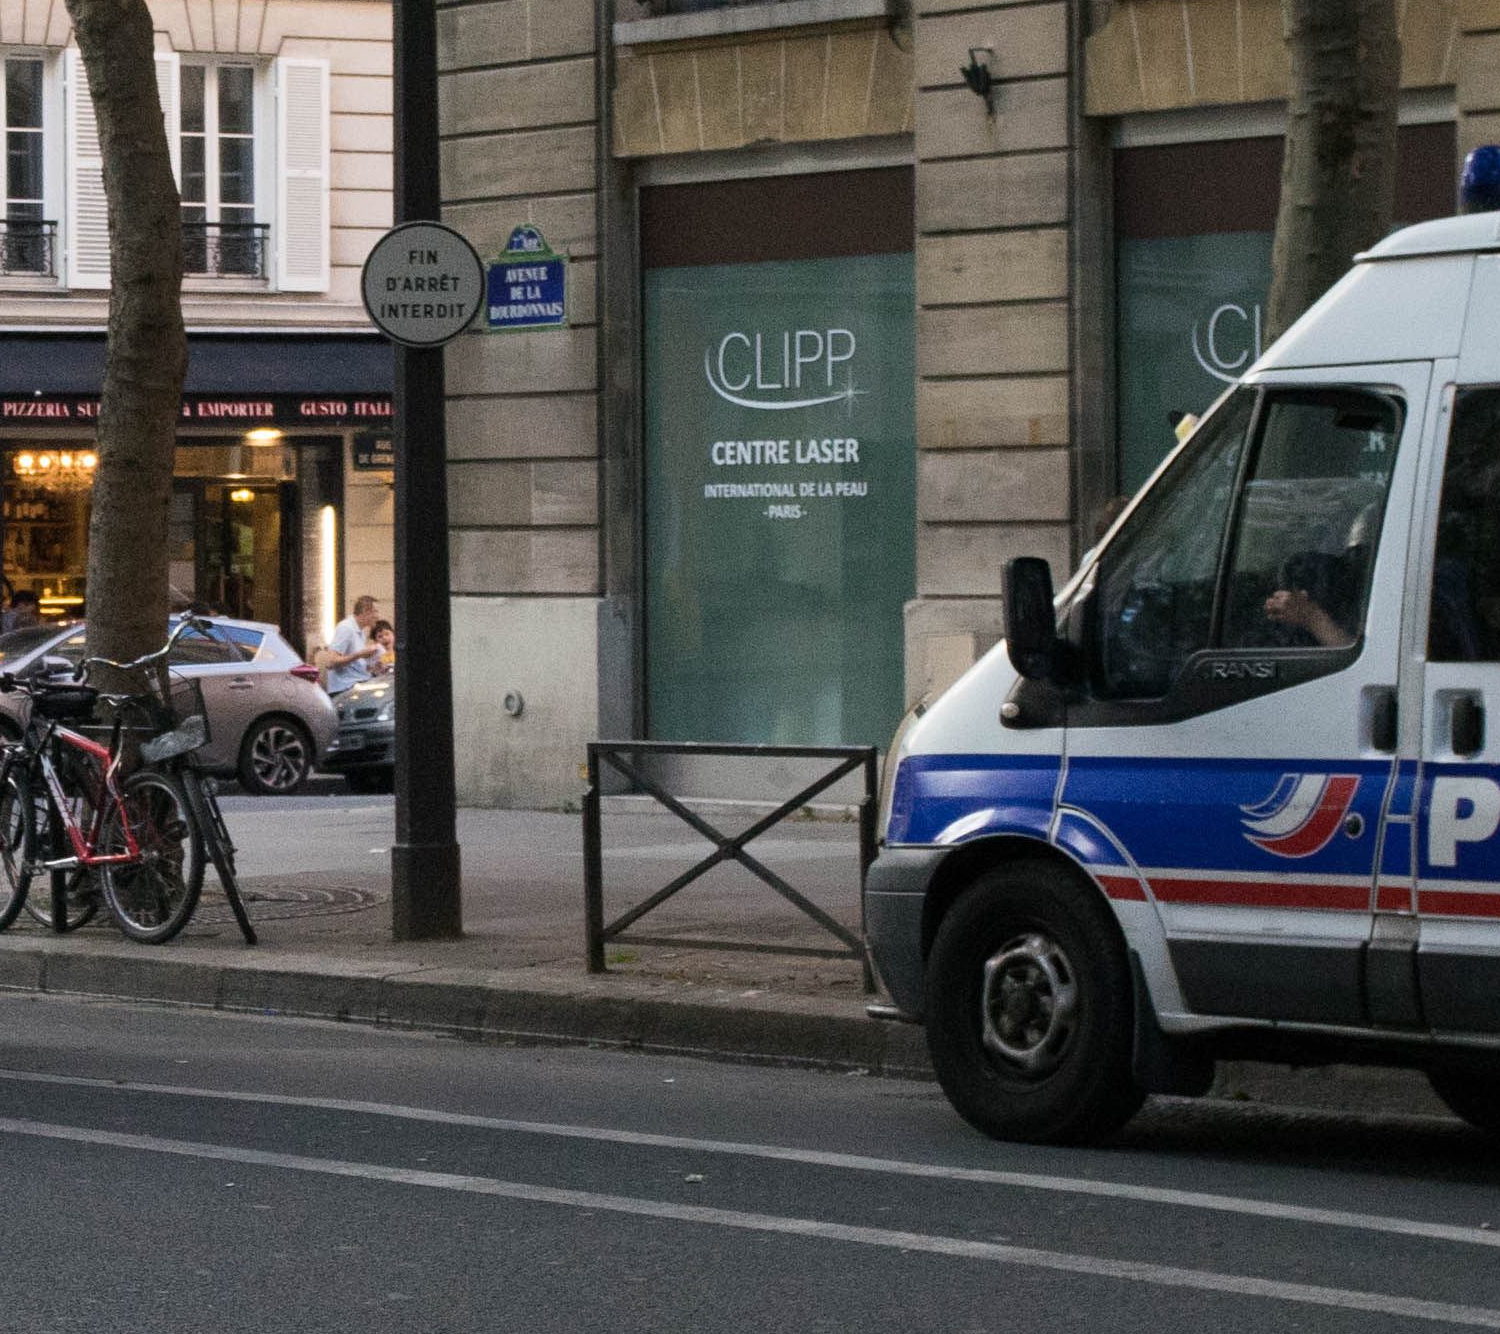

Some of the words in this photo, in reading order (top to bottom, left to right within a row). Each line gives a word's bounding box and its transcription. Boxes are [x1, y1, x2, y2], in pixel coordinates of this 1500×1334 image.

[408, 250, 438, 265] FIN
[386, 273, 461, 292] D'ARRÊT
[504, 266, 549, 284] AVENUE
[509, 286, 525, 301] DE
[526, 285, 542, 300] LA
[381, 303, 466, 318] INTERDIT
[718, 328, 856, 391] CLIPP
[3, 402, 71, 418] PIZZERIA
[198, 402, 275, 418] EMPORTER
[300, 401, 348, 417] GUSTO
[711, 439, 790, 466] CENTRE
[795, 437, 860, 464] LASER
[704, 482, 796, 499] INTERNATIONAL
[799, 482, 816, 497] DE
[818, 482, 833, 497] LA
[835, 481, 868, 497] PEAU
